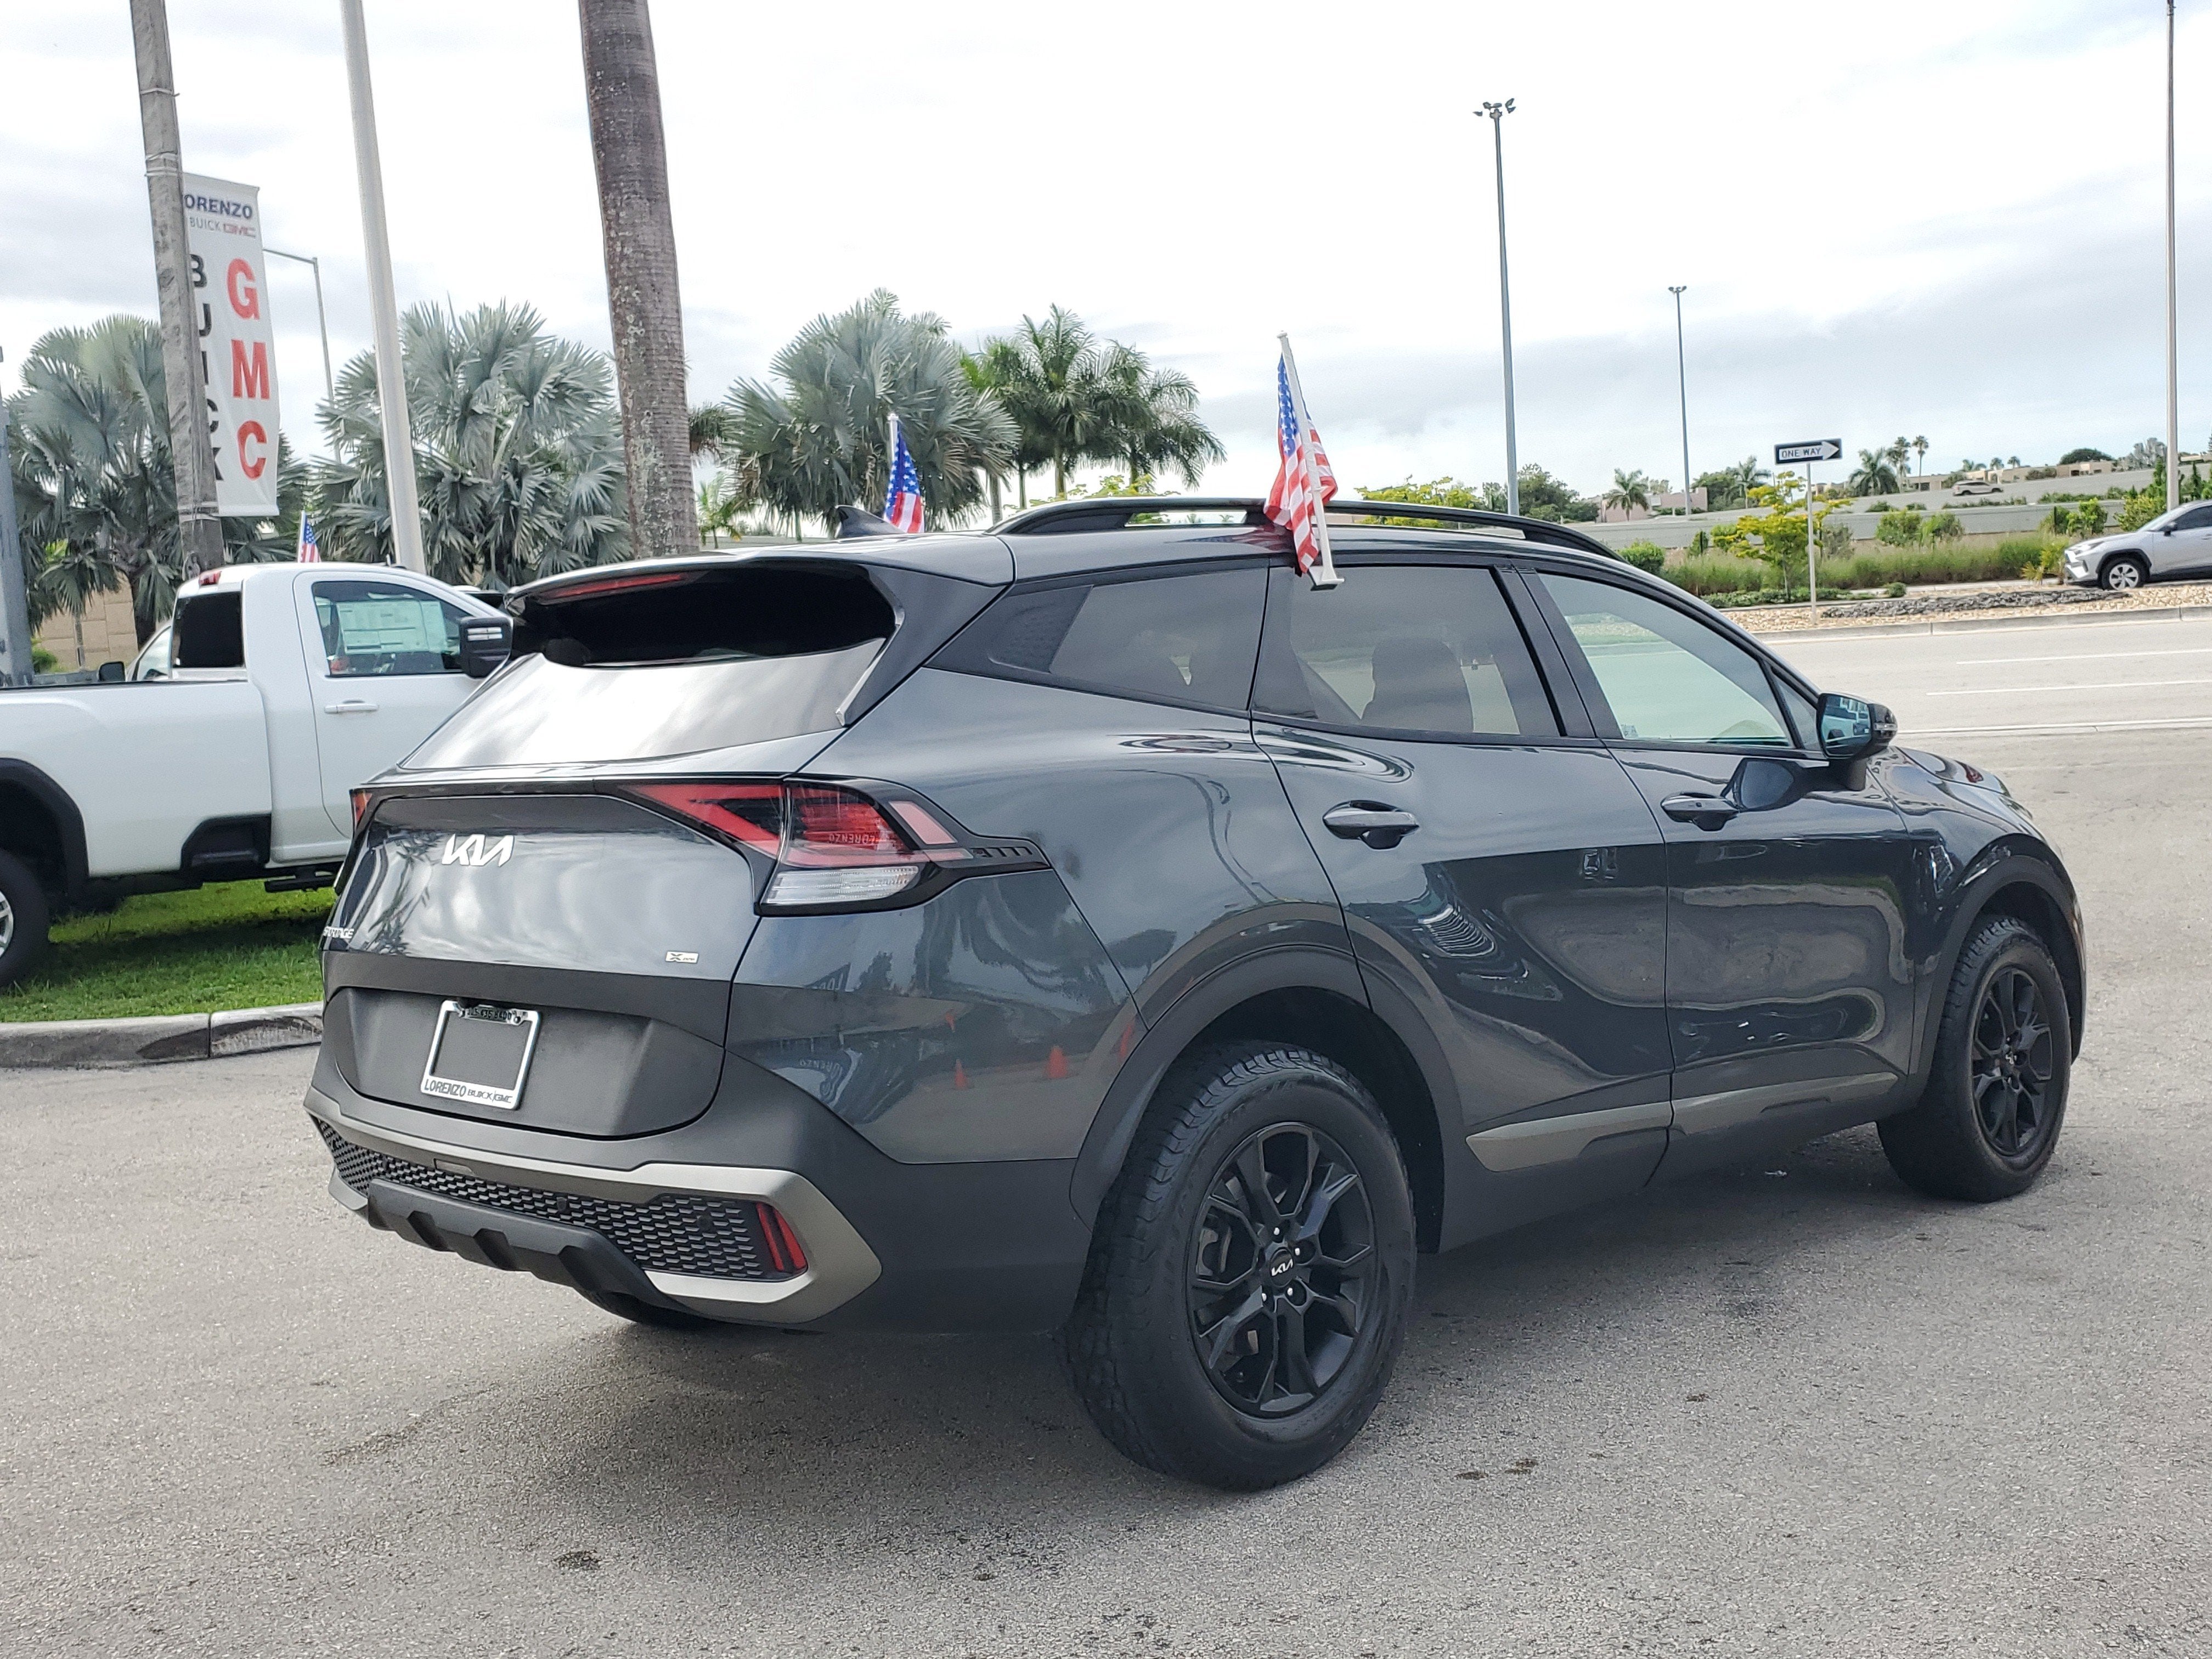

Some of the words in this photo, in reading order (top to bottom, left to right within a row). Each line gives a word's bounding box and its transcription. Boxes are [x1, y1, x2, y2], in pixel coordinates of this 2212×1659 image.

[182, 194, 252, 219] ORENZO
[189, 217, 221, 231] BUICK
[223, 223, 256, 238] GMC
[226, 258, 270, 480] GMC
[1781, 450, 1800, 459] ONE
[1803, 447, 1821, 456] WAY
[442, 833, 515, 867] KIA
[425, 1079, 466, 1097] LORENZO
[1271, 1259, 1293, 1276] KIA
